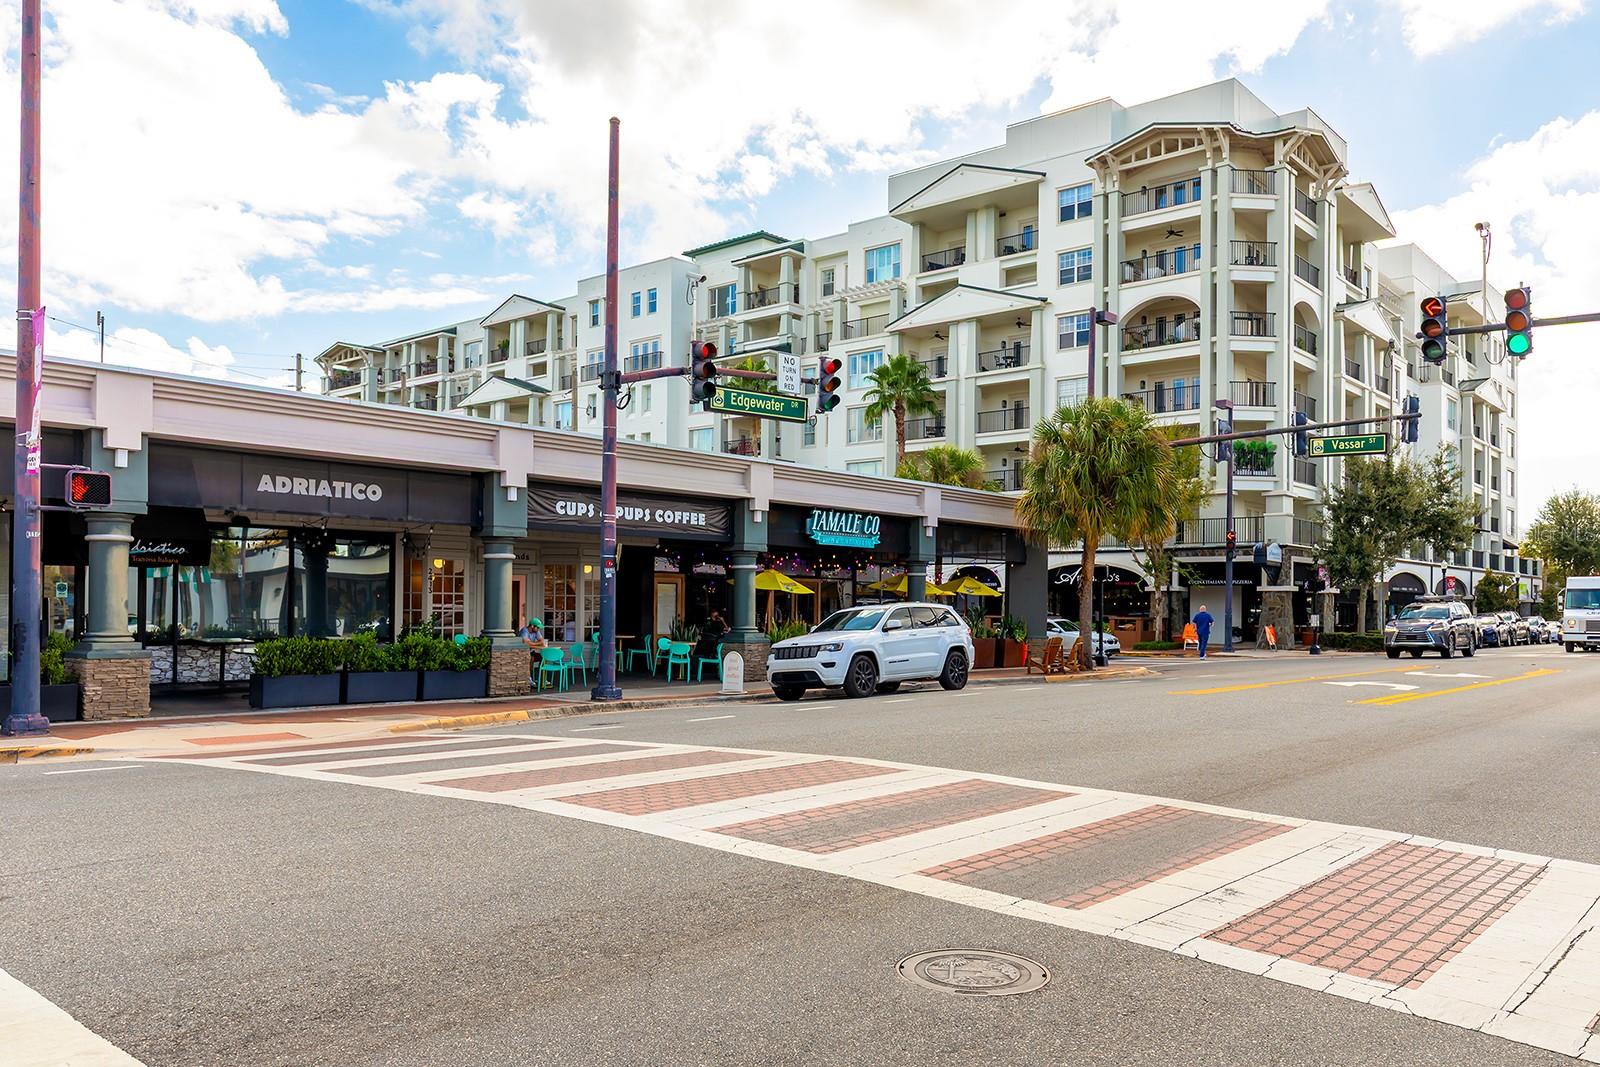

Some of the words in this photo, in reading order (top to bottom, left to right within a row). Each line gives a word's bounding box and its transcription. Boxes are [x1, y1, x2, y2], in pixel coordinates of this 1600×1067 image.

[784, 357, 796, 366] NO
[783, 366, 797, 375] TURN
[784, 382, 795, 391] RED
[730, 392, 785, 411] Edgewater
[1331, 439, 1366, 450] Vassar
[256, 474, 383, 502] ADRIATICO
[555, 501, 595, 518] CUPS
[615, 505, 650, 522] PUPS
[655, 509, 706, 526] COFFEE
[811, 509, 863, 534] TAMALE
[864, 515, 881, 535] CO.
[130, 539, 187, 554] driatico
